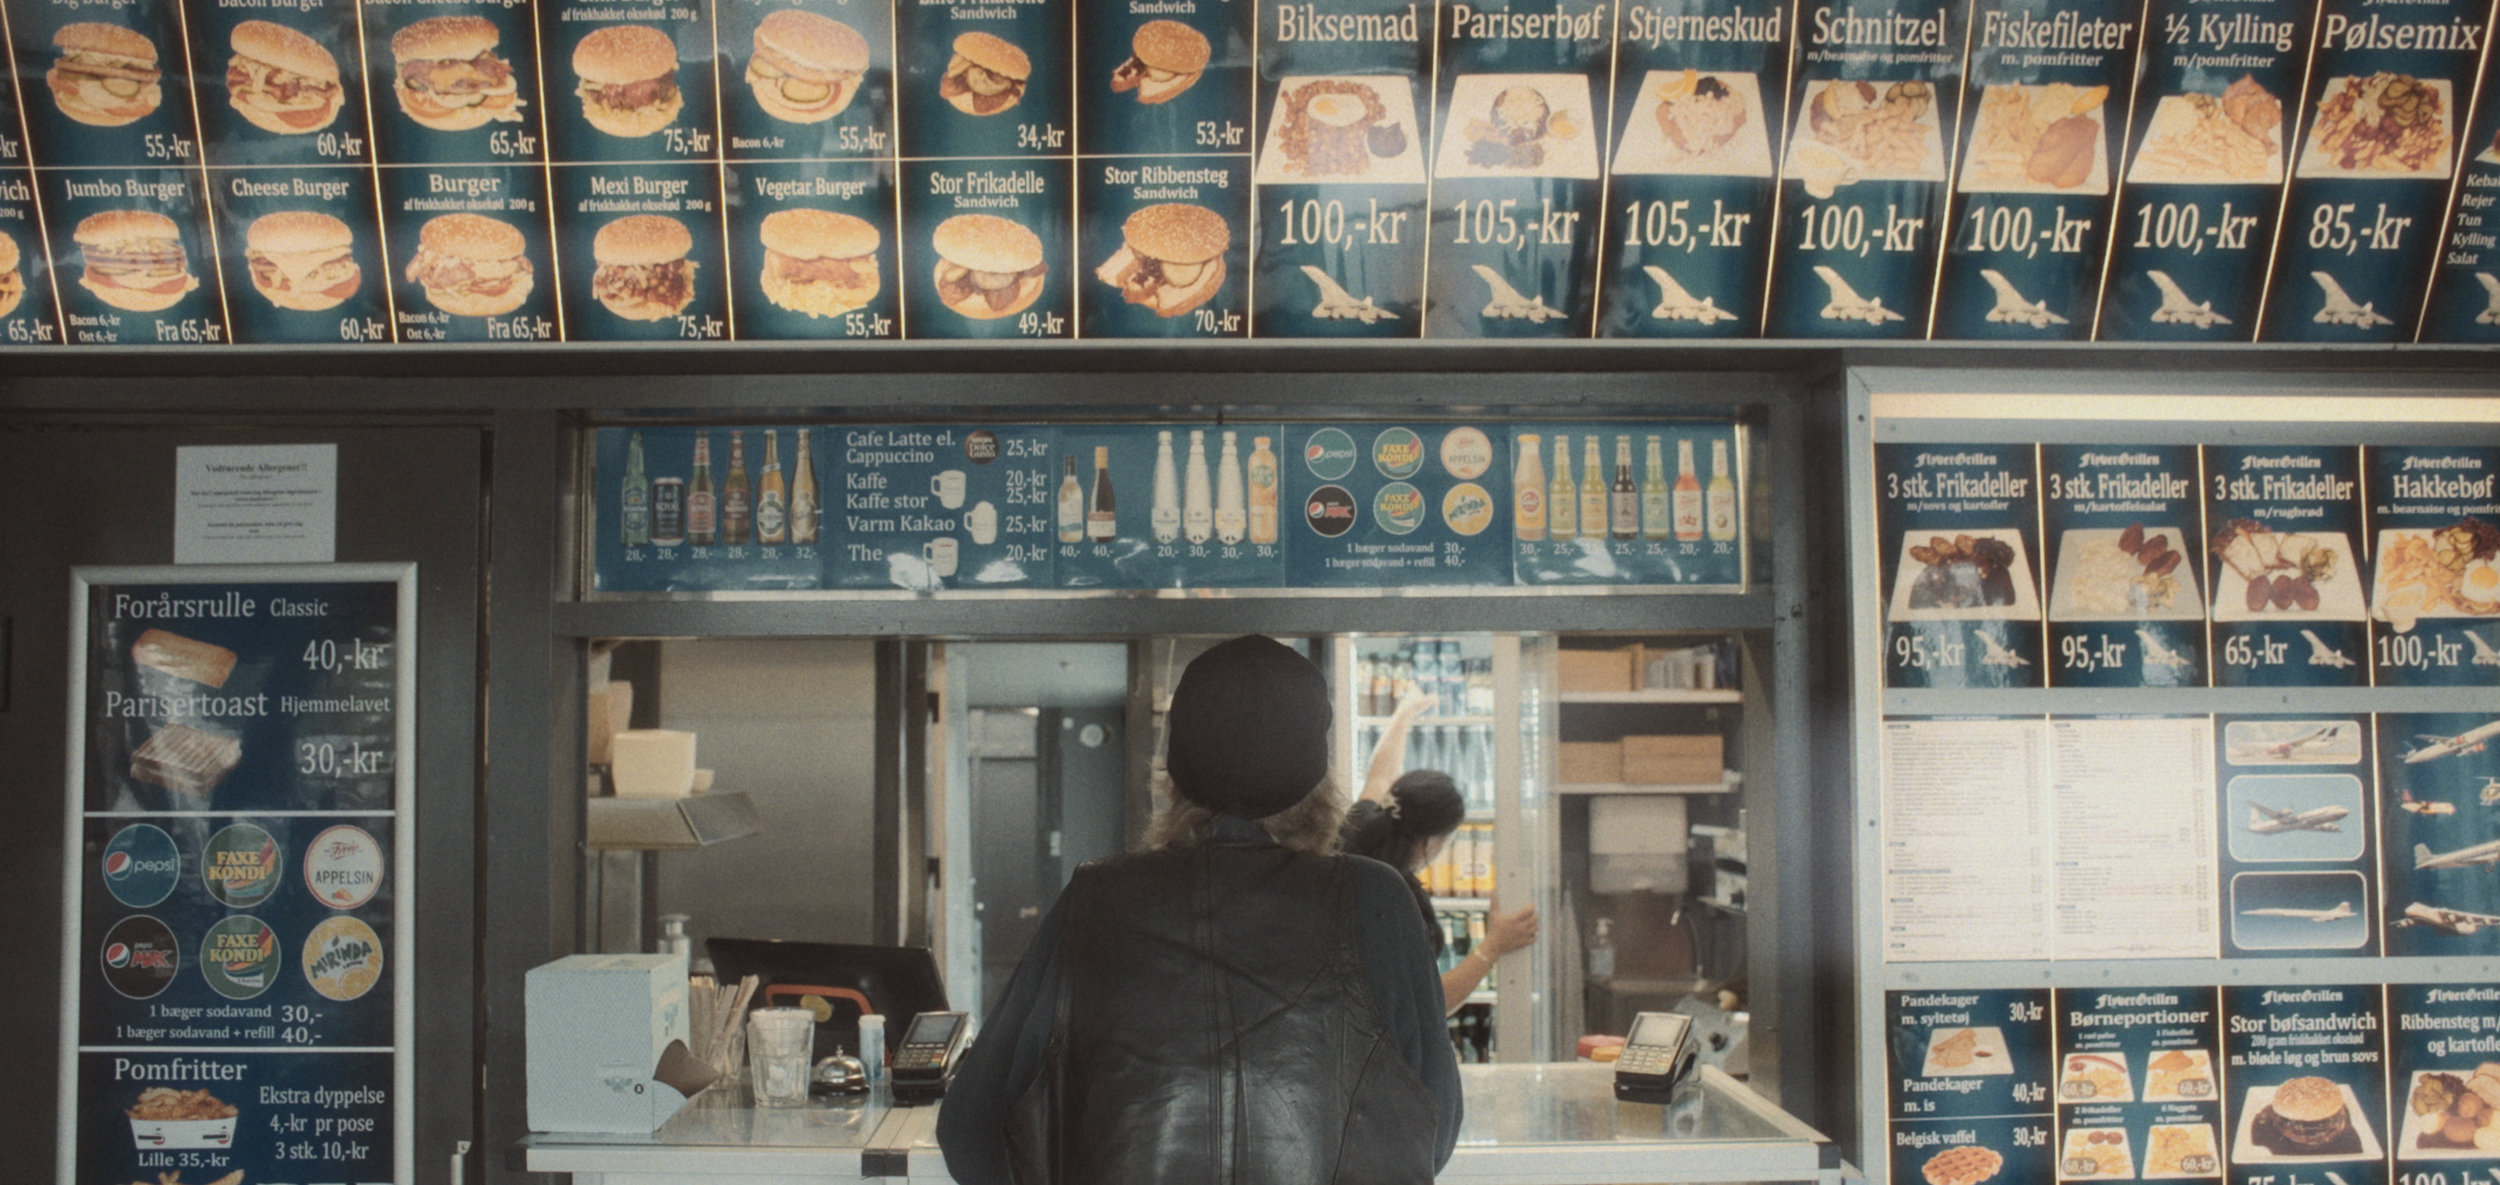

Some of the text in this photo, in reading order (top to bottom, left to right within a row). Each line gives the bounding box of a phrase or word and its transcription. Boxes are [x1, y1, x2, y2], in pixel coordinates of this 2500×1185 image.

[671, 8, 688, 20] 200
[690, 12, 697, 22] g
[951, 6, 1016, 19] Sandwich
[1129, 1, 1195, 14] Sandwich
[1277, 5, 1419, 42] Biksemad
[1451, 4, 1604, 42] Pariserbøf
[1628, 6, 1782, 47] Stjerneskud
[1812, 6, 1946, 46] Schnitzel
[1981, 10, 2132, 50] Fiskefileter
[2199, 13, 2294, 52] Kylling
[2322, 13, 2482, 51] Pølsemix
[2001, 52, 2103, 68] m. pomfritter
[317, 132, 362, 158] 60,-kr
[490, 131, 536, 157] 65,-kr
[663, 129, 710, 155] 75,-kr
[839, 126, 886, 151] 55,-kr
[1017, 124, 1065, 150] 34,-kr
[1196, 121, 1244, 148] 53,-kr
[145, 134, 191, 160] 55,-kr
[429, 174, 501, 195] Burger
[591, 176, 688, 197] Mexi Burger
[930, 171, 1044, 194] Stor Frikadelle
[1105, 166, 1228, 188] Stor Ribbensteg
[66, 179, 185, 199] Jumbo Burger
[232, 178, 349, 199] Cheese Burger
[755, 178, 866, 199] Vegetar Burger
[1133, 186, 1198, 199] Sandwich
[954, 196, 1018, 208] Sandwich
[2461, 194, 2496, 210] Rejer
[1280, 199, 1406, 251] 100,-kr
[1453, 199, 1579, 252] 105,-kr
[1624, 199, 1750, 254] 105,-kr
[1799, 204, 1923, 256] 100,-kr
[1967, 204, 2091, 257] 100,-kr
[2133, 202, 2257, 256] 100,-kr
[2308, 203, 2412, 256] 85,-kr
[2457, 213, 2482, 227] Tun
[8, 320, 53, 342] 65,-kr
[70, 314, 121, 327] Bacon 6,-kr
[156, 320, 220, 342] Fra 65,-kr
[340, 318, 384, 342] 60,-kr
[487, 316, 552, 340] Fra 65,-kr
[678, 315, 722, 340] 75,-kr
[846, 313, 891, 338] 55,-kr
[1019, 312, 1064, 337] 49,-kr
[1195, 310, 1240, 335] 70,-kr
[79, 331, 117, 343] Ost 6,-kr
[846, 431, 883, 446] Cafe
[888, 431, 932, 446] Latte
[936, 430, 956, 446] el.
[1006, 439, 1047, 458] 25,-kr
[846, 449, 934, 467] Cappuccino
[1378, 453, 1415, 463] KONDI
[847, 473, 887, 489] Kaffe
[1006, 470, 1047, 488] 20,-kr
[1888, 472, 2027, 499] 3 stk. Frikadeller
[2050, 473, 2188, 499] 3 stk. Frikadeller
[2215, 474, 2353, 500] 3 stk. Frikadeller
[2393, 474, 2494, 499] Hakkebøf
[847, 493, 928, 509] Kaffe stor
[2253, 506, 2324, 519] m/rugbrød
[847, 515, 955, 532] Varm Kakao
[1006, 515, 1047, 534] 25,-kr
[625, 550, 647, 562] 28,-
[657, 548, 678, 560] 28,-
[848, 544, 882, 561] The
[1355, 543, 1385, 555] bæger
[1388, 543, 1434, 553] sodavand
[1444, 543, 1465, 555] 30,-
[1615, 543, 1636, 556] 25,-
[1713, 542, 1734, 555] 20,-
[114, 591, 328, 619] Forårsrulle Classic
[302, 638, 384, 674] 40,-kr
[1896, 635, 1964, 671] 95,-kr
[2061, 636, 2125, 672] 95,-kr
[2224, 635, 2289, 669] 65,-kr
[2378, 635, 2462, 671] 100,-kr
[105, 691, 390, 718] Parisertoast Hjemmelavet
[301, 742, 383, 778] 30,-kr
[134, 858, 175, 874] pepsi
[216, 852, 261, 866] FAXE
[208, 866, 265, 880] KONDI
[315, 870, 374, 885] APPELSIN
[216, 935, 259, 948] FAXE
[209, 949, 264, 962] KONDI
[309, 935, 374, 980] MIRINDA
[1901, 994, 1979, 1010] Pandekager
[2009, 1002, 2044, 1022] 30,-kr
[149, 1004, 323, 1025] 1 bæger sodavand 30,-
[2070, 1011, 2209, 1029] Børneportioner
[2230, 1011, 2376, 1033] Stor bøfsandwich
[116, 1025, 323, 1046] 1 bæger sodavand + refill 40,-
[114, 1058, 248, 1082] Pomfritter
[1903, 1078, 1983, 1094] Pandekager
[259, 1086, 385, 1109] Ekstra dyppelse
[1904, 1100, 1936, 1112] m. is
[269, 1114, 374, 1136] 4,-kr pr pose
[1897, 1130, 1976, 1147] Belgisk vaffel
[2013, 1127, 2047, 1147] 30,-kr
[138, 1152, 230, 1169] Lille 35,-kr
[275, 1142, 369, 1162] 3 stk. 10,-kr
